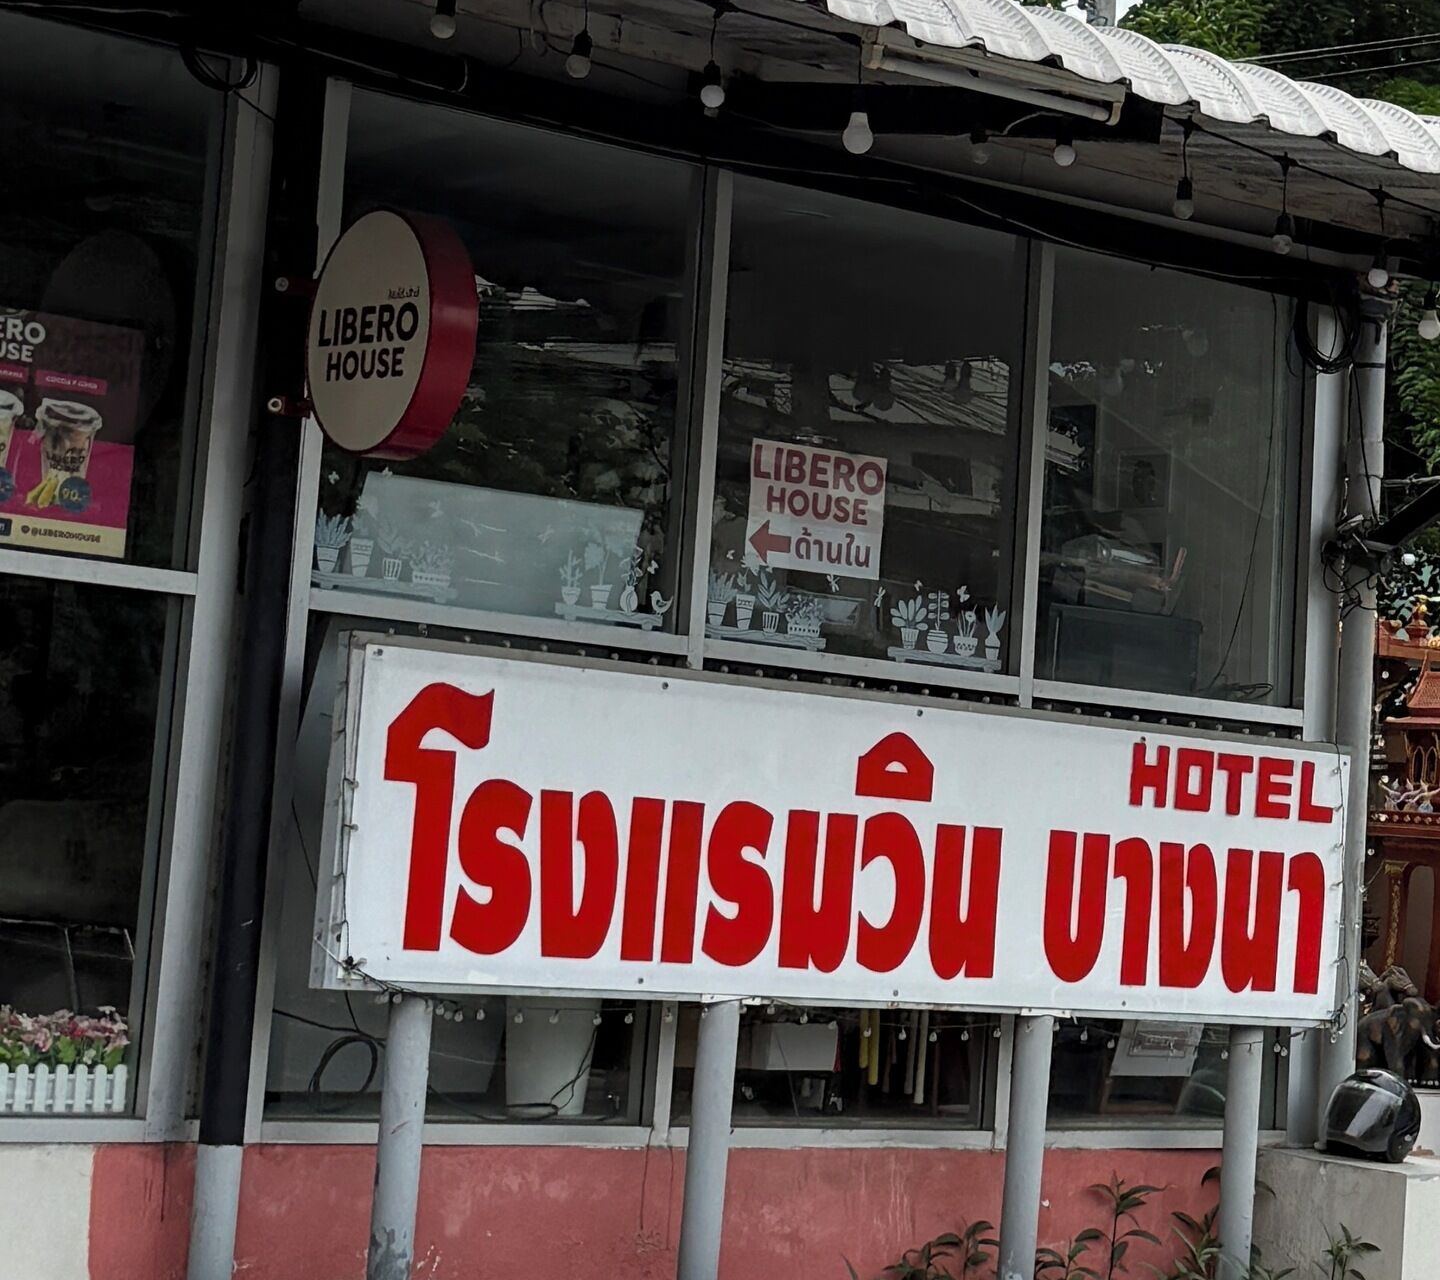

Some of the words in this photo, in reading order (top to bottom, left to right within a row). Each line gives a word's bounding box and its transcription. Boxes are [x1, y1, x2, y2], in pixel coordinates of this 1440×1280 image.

[318, 302, 419, 347] LIBERO
[326, 347, 405, 382] HOUSE
[753, 444, 884, 496] LIBERO
[767, 485, 868, 526] HOUSE
[795, 527, 871, 568] ด้านใน
[1130, 741, 1332, 824] HOTEL
[384, 681, 1003, 981] โรงแรมวิน
[1044, 829, 1326, 996] บางนา
